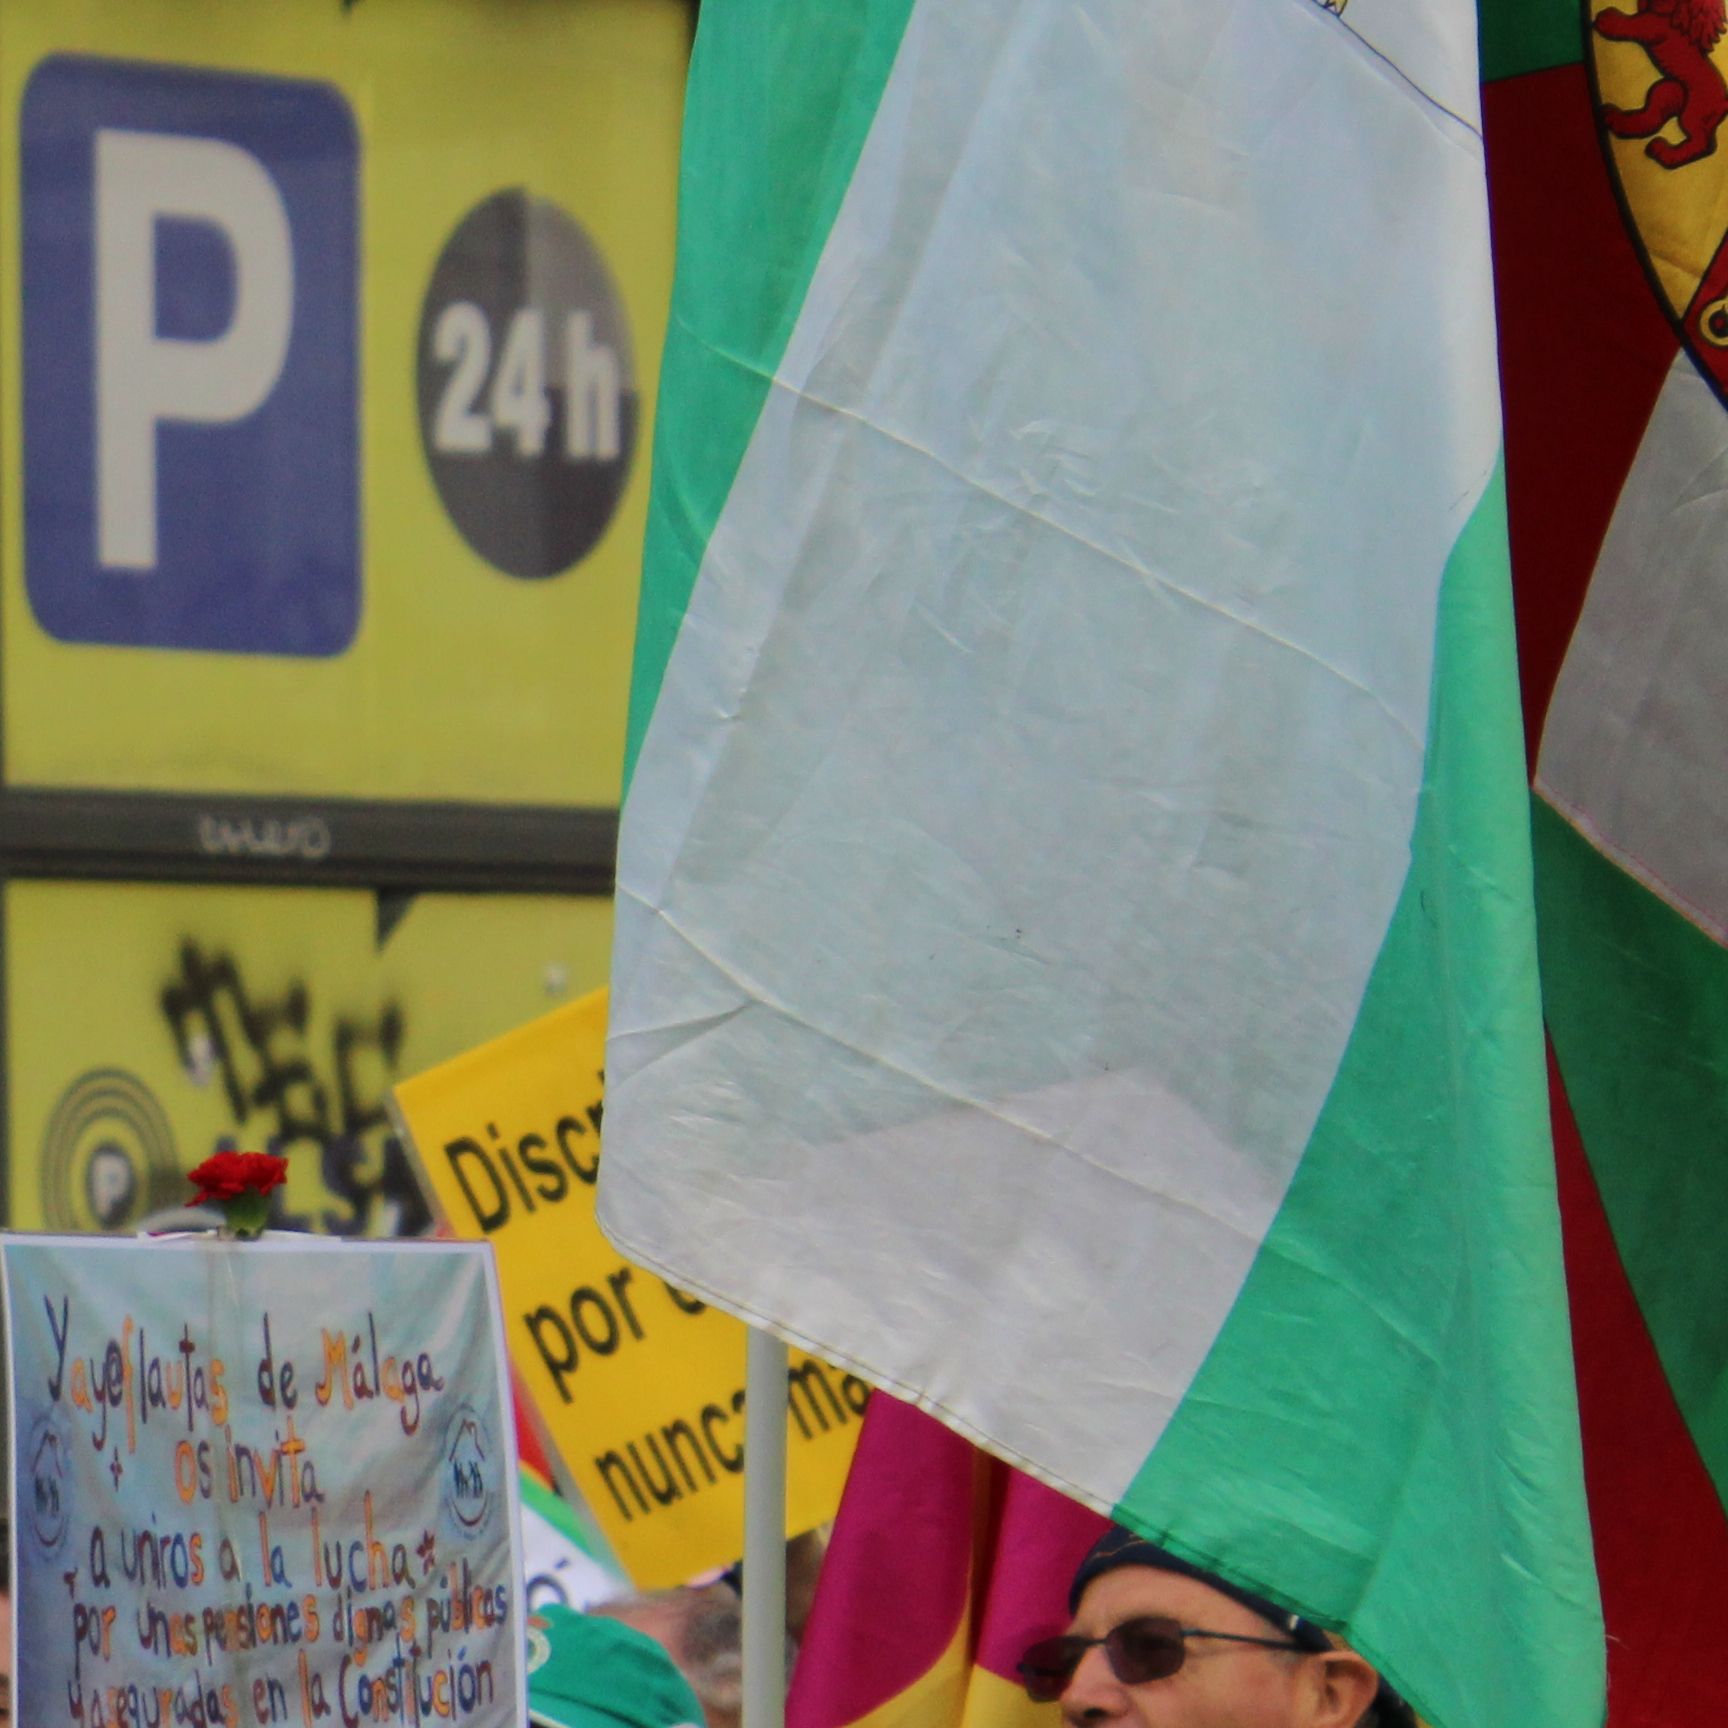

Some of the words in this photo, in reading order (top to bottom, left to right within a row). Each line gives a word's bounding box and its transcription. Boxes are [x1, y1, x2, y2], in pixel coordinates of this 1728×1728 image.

[95, 127, 294, 569] P
[256, 1311, 298, 1410] de
[313, 1312, 445, 1437] Málaga
[523, 1266, 647, 1403] por
[174, 1439, 212, 1504] os
[594, 1388, 748, 1522] nunc
[257, 1508, 293, 1589] la
[312, 1490, 416, 1593] lucha
[72, 1602, 117, 1680] por
[252, 1676, 289, 1725] en
